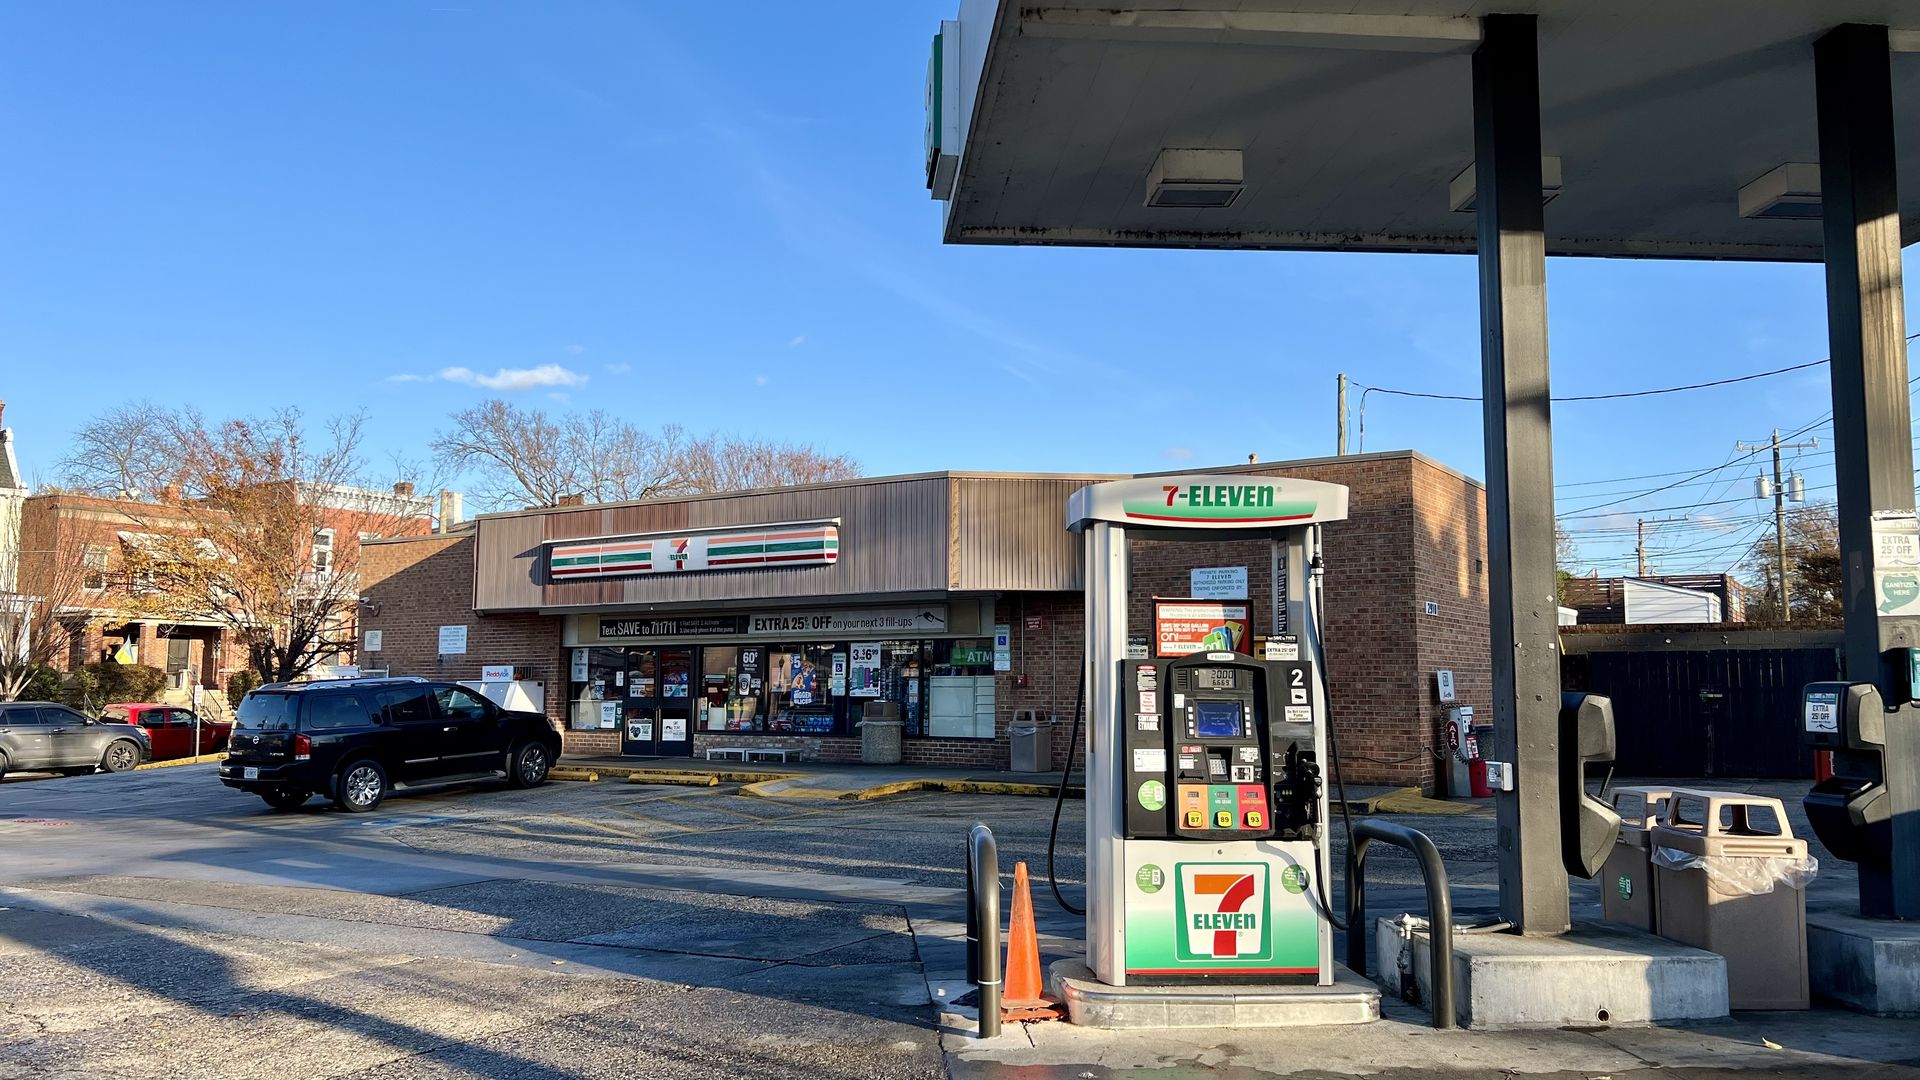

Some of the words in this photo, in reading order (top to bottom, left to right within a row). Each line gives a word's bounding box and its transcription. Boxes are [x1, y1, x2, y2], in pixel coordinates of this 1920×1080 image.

[1881, 536, 1910, 544] EXTRA
[671, 539, 689, 570] 7
[1897, 546, 1912, 554] OFF
[602, 625, 617, 636] Text
[617, 622, 640, 635] SAVE
[642, 625, 650, 635] to
[650, 620, 677, 635] 711711
[754, 616, 789, 631] EXTRA
[811, 615, 832, 630] OFF
[832, 620, 842, 629] on
[843, 619, 859, 632] your
[860, 617, 878, 628] next
[879, 617, 885, 627] 3
[885, 616, 913, 629] fill-ups
[743, 651, 758, 663] 60¢
[853, 649, 859, 661] 3
[967, 651, 993, 662] ATM
[1291, 669, 1304, 686] 2
[1448, 725, 1458, 746] AIR
[1194, 874, 1255, 956] 7
